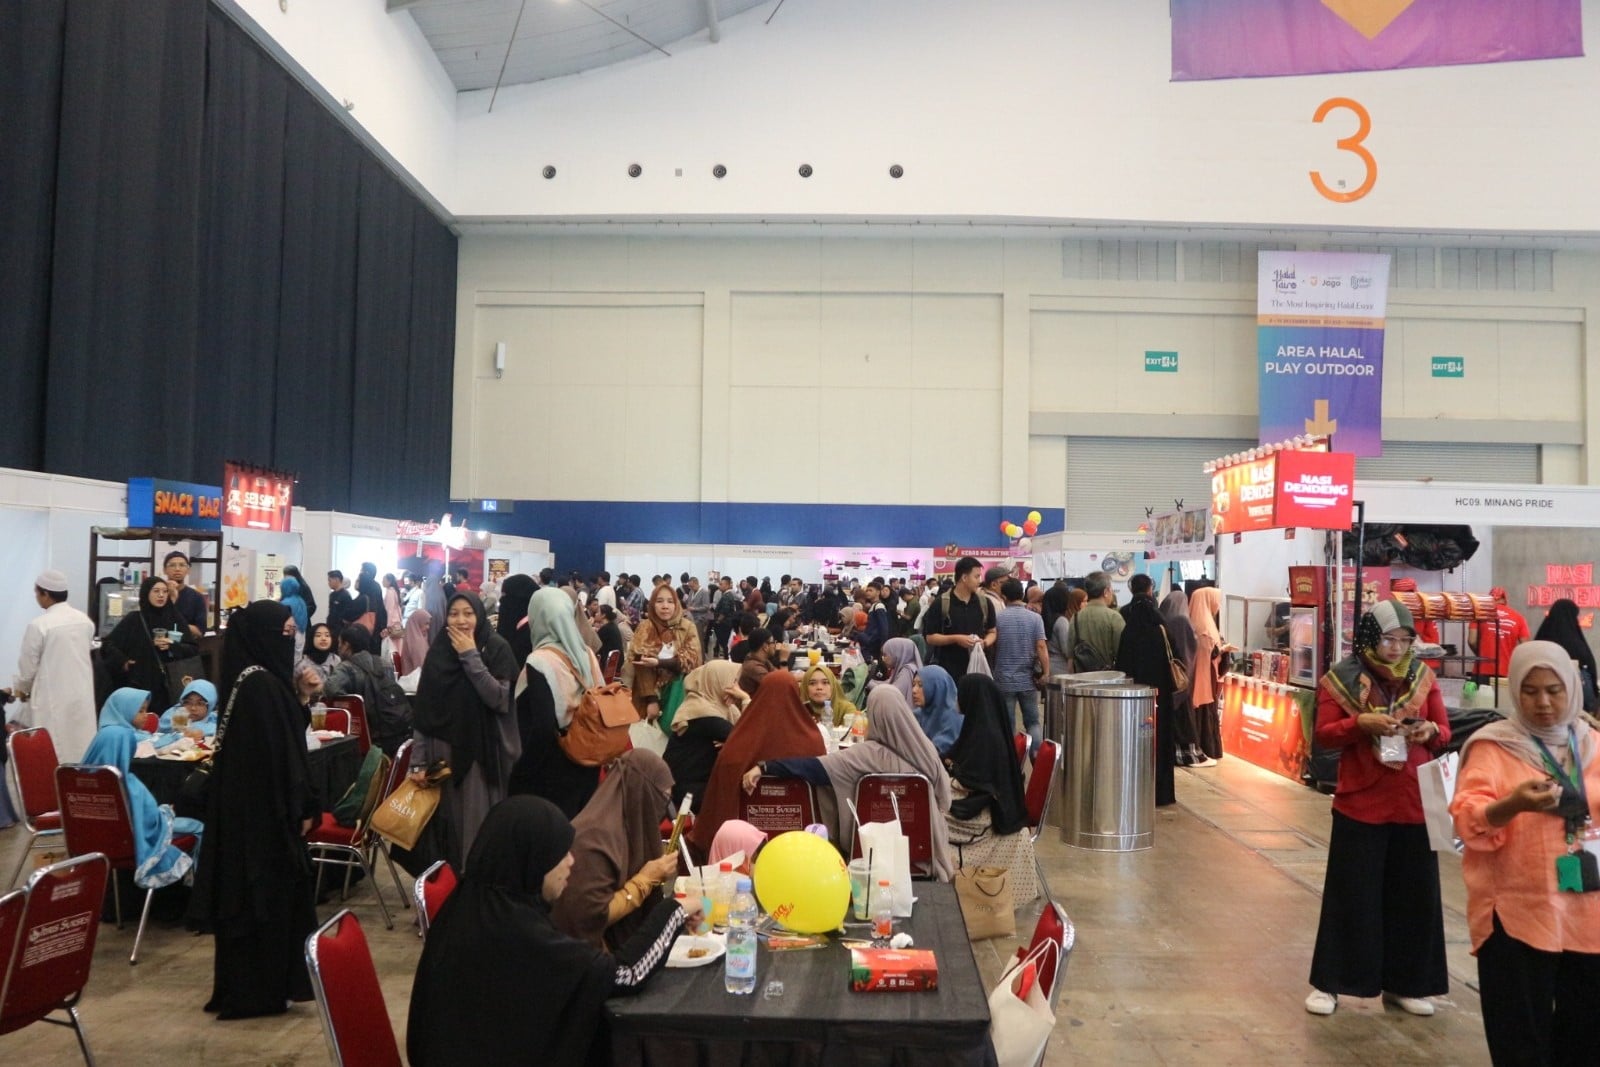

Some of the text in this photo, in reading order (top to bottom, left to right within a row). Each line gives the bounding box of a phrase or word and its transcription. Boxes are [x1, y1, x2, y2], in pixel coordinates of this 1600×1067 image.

[1309, 97, 1378, 203] 3
[1321, 279, 1342, 289] Jago
[1272, 300, 1283, 308] The
[1286, 300, 1303, 308] Most
[1305, 300, 1336, 311] Inspiring
[1337, 301, 1355, 310] Halal
[1277, 345, 1365, 359] AREA HALAL
[1265, 362, 1375, 376] PLAY OUTDOOR
[1300, 474, 1332, 484] NASI
[1283, 481, 1349, 495] DENDENG
[155, 490, 194, 516] SNACK
[198, 495, 220, 518] BAR
[1455, 498, 1553, 508] HC09. MINANG PRIDE
[1546, 563, 1593, 584] NASI
